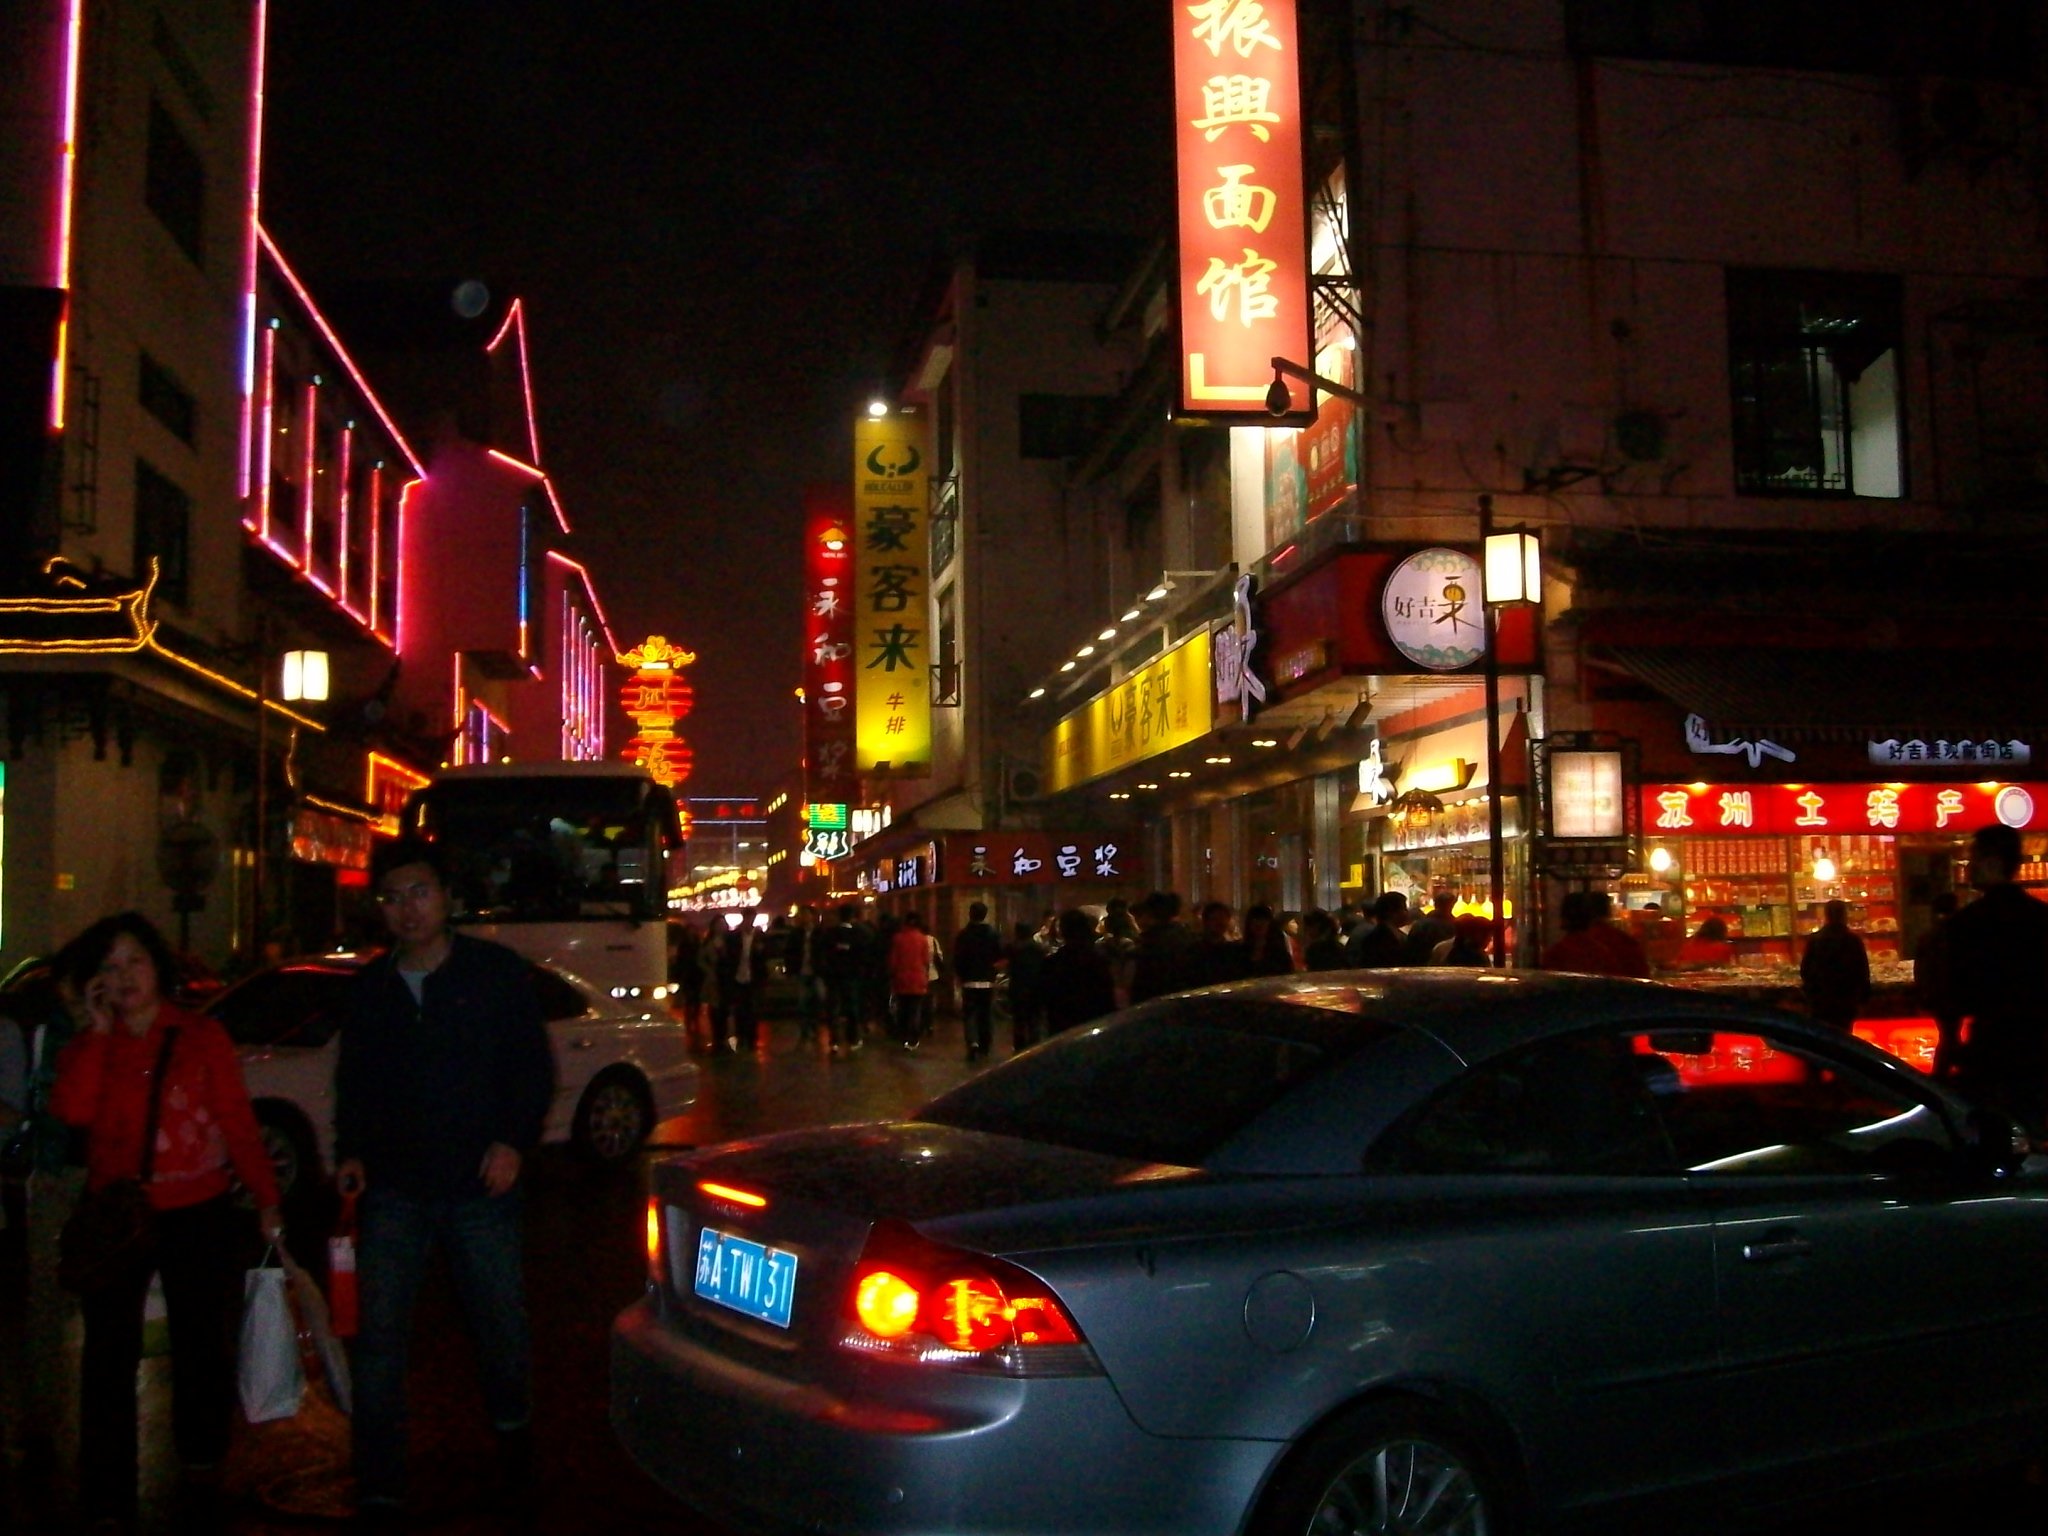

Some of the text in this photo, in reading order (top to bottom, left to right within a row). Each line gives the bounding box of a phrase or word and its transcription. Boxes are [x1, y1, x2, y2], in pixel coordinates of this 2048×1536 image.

[865, 504, 920, 672] 豪客来
[886, 692, 906, 735] 牛排
[1125, 664, 1171, 748] 豪客来
[1656, 789, 1965, 829] 苏州土特产
[971, 843, 1120, 877] 永和豆浆
